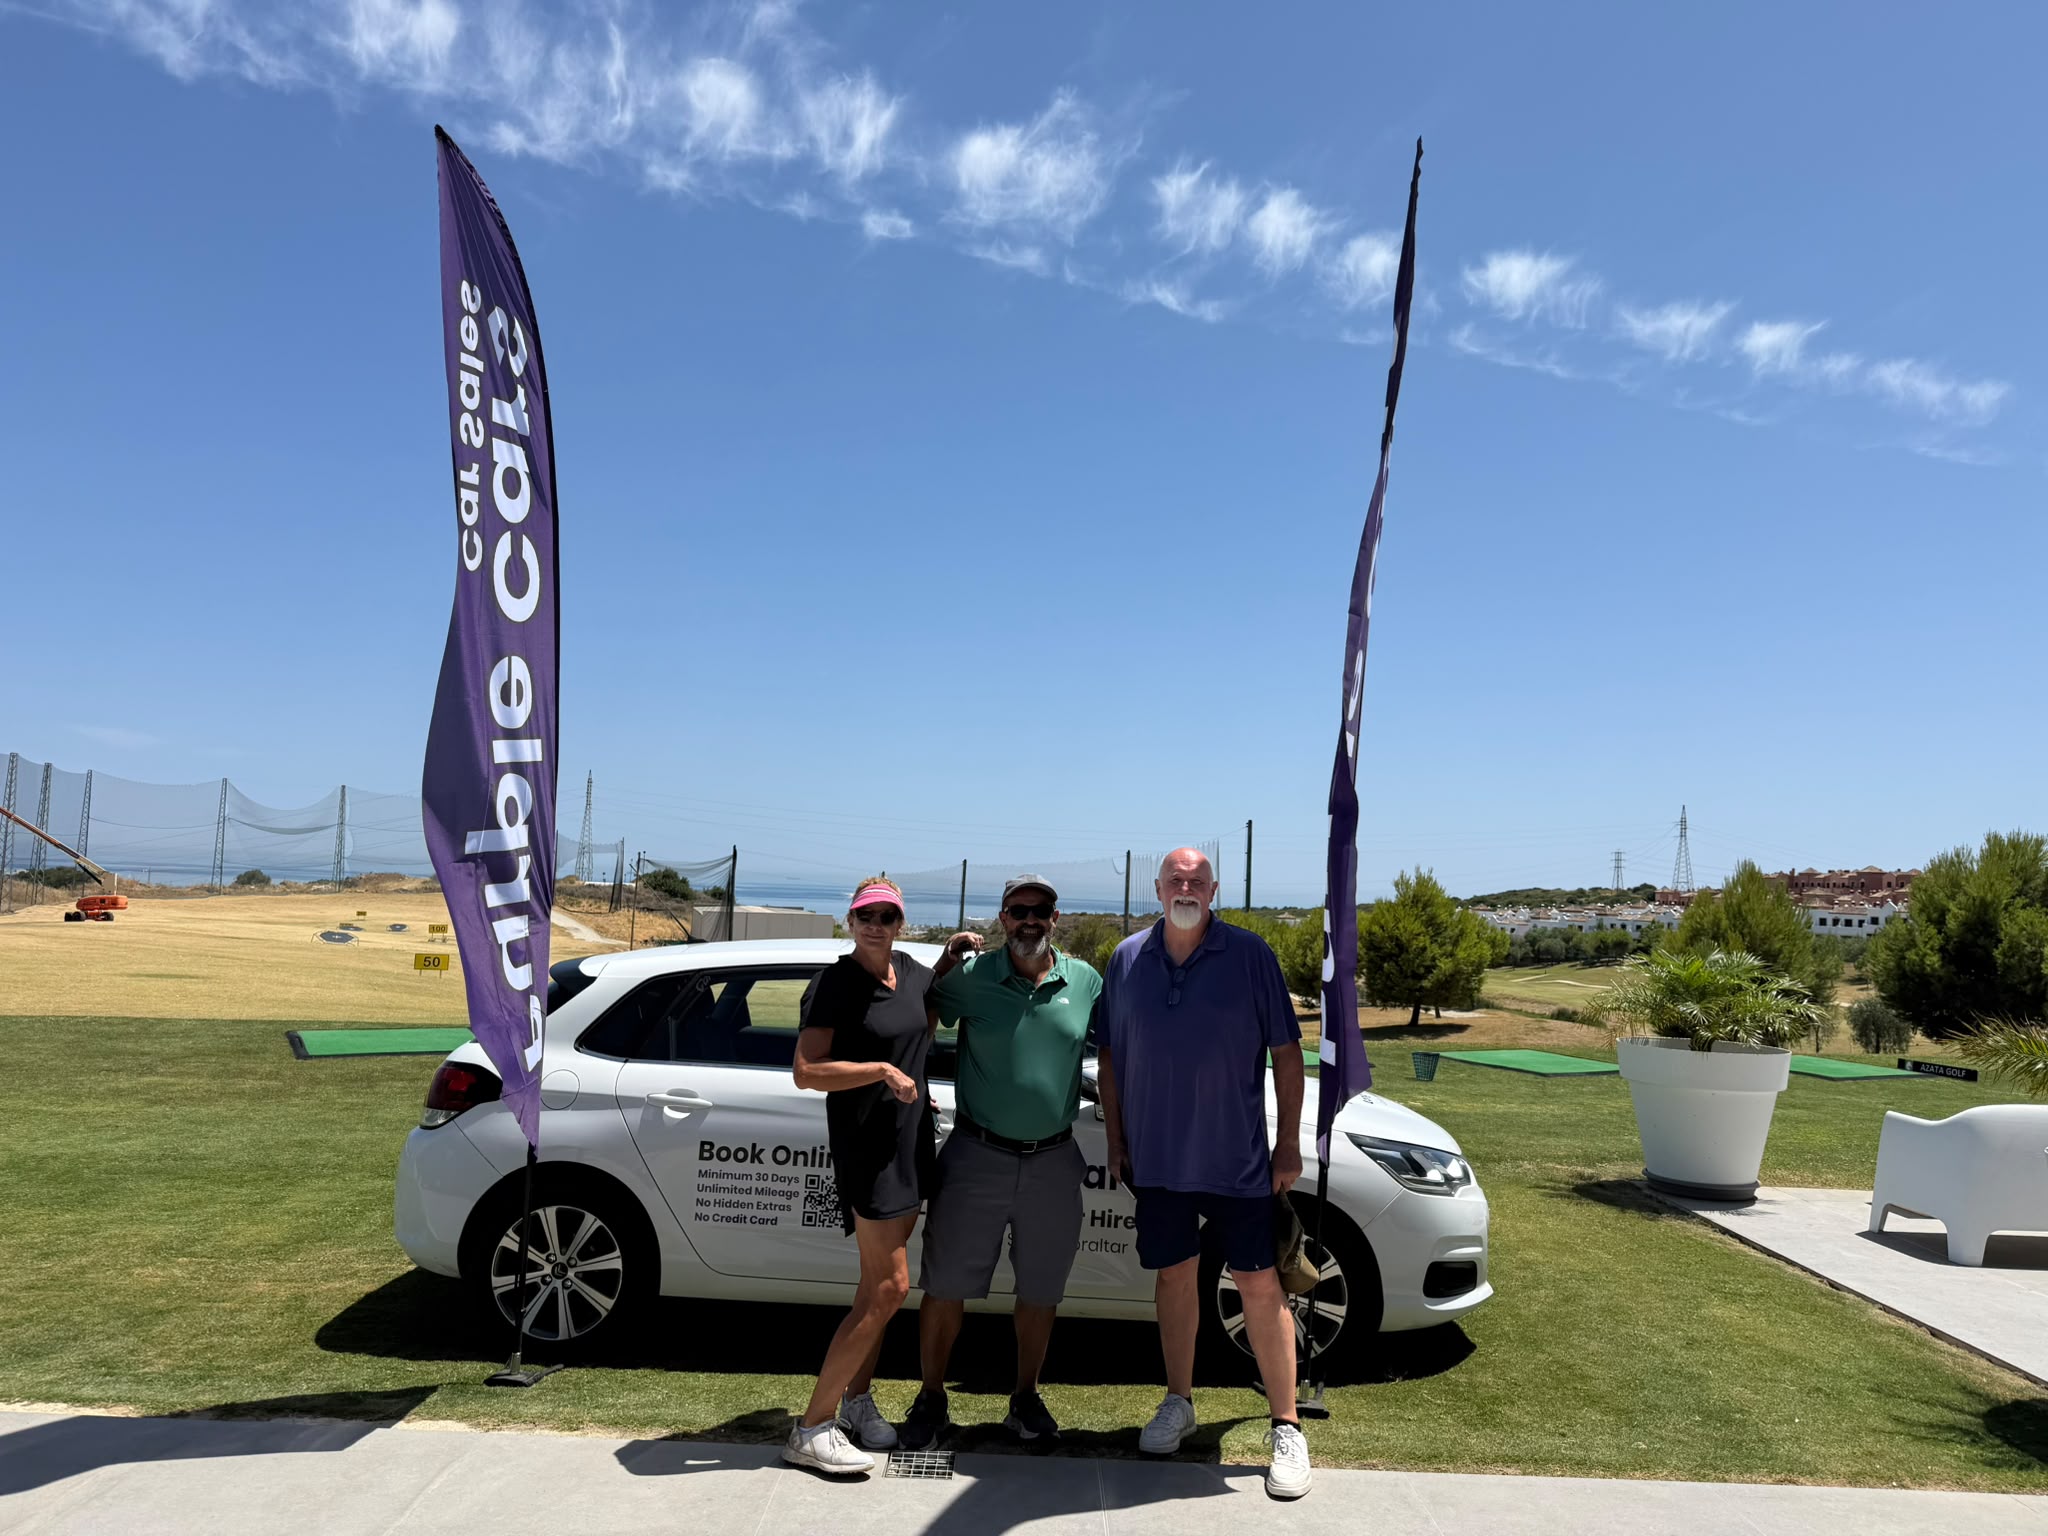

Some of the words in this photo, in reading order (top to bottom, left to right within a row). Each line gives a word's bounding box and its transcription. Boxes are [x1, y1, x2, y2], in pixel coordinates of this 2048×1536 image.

[423, 956, 441, 968] 50
[1920, 1063, 1944, 1074] AZATA
[1945, 1068, 1966, 1078] GOLF
[698, 1140, 766, 1165] Book
[771, 1145, 833, 1169] Onli
[698, 1169, 753, 1182] Minimum
[755, 1172, 769, 1182] 30
[771, 1173, 800, 1186] Days
[697, 1183, 753, 1195] Unlimited
[754, 1186, 800, 1200] Mileage
[695, 1198, 711, 1208] No
[713, 1199, 754, 1210] Hidden
[756, 1201, 792, 1212] Extras
[694, 1212, 710, 1222] No
[712, 1213, 747, 1225] Credit
[749, 1215, 778, 1226] Card
[1090, 1209, 1136, 1230] Hire
[1077, 1238, 1128, 1254] raltar
